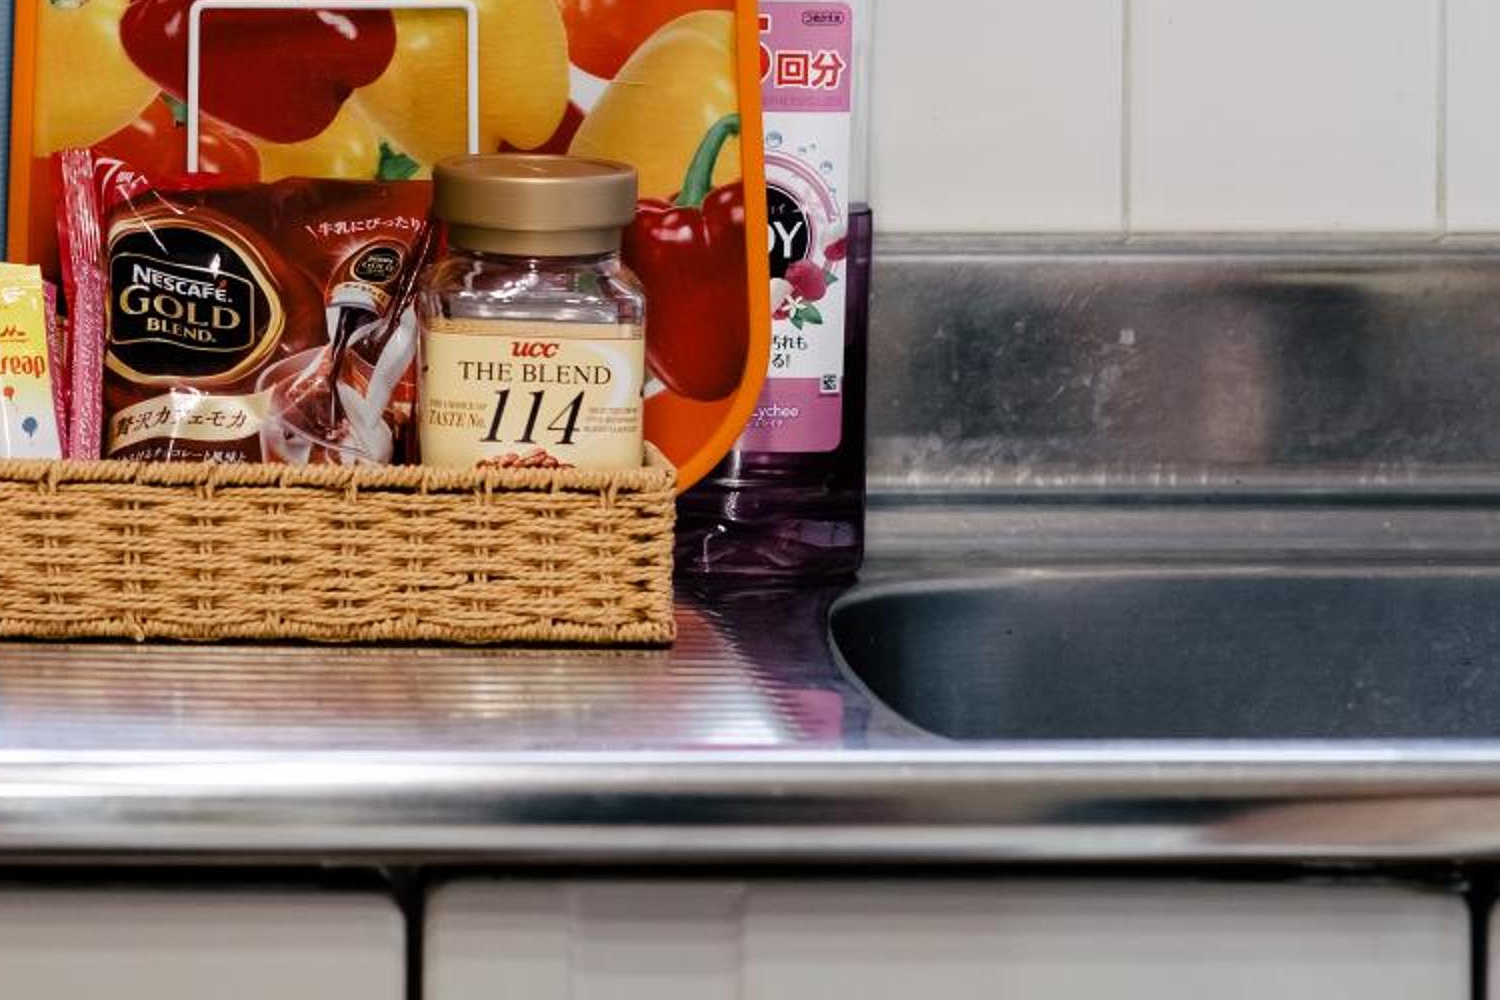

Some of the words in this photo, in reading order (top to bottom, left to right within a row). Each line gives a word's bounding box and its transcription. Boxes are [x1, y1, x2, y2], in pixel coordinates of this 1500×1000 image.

[318, 215, 421, 236] 牛乳にぴったり
[119, 285, 242, 330] GOLD
[146, 316, 217, 344] BLEND
[457, 360, 514, 382] THE
[522, 364, 612, 386] BLEND
[479, 388, 586, 446] 114
